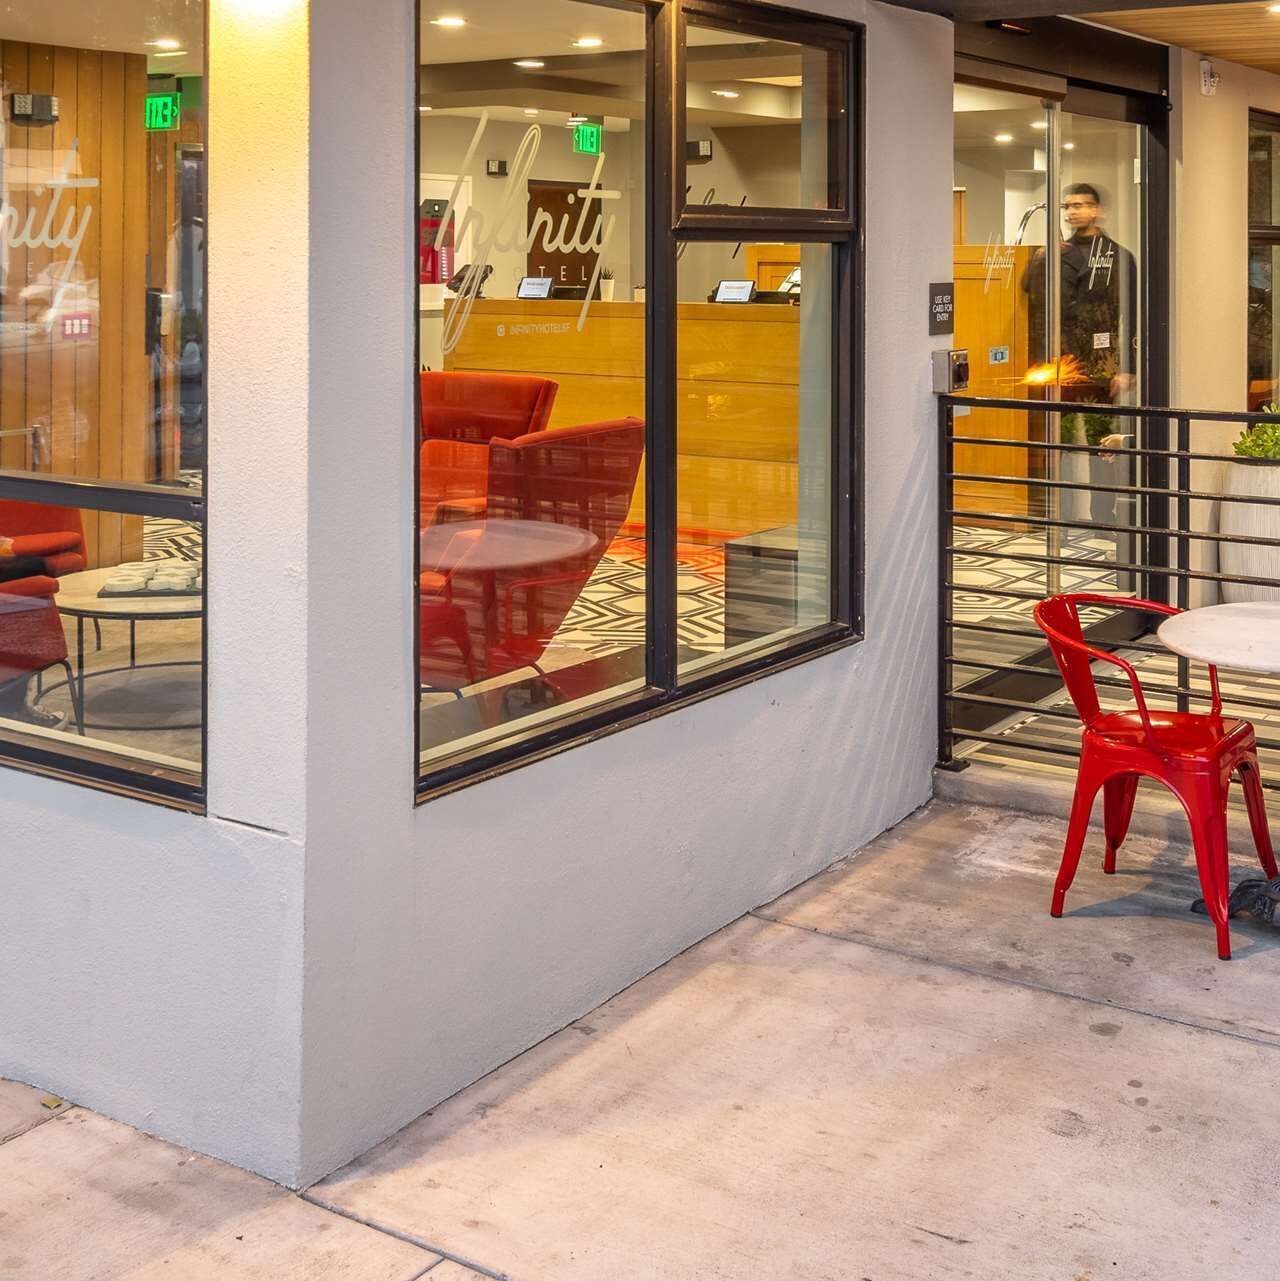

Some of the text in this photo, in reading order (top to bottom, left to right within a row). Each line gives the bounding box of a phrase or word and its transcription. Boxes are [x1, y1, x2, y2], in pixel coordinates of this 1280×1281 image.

[433, 109, 622, 355] Infinity
[934, 295, 943, 304] USE
[932, 303, 953, 313] CARD FOR
